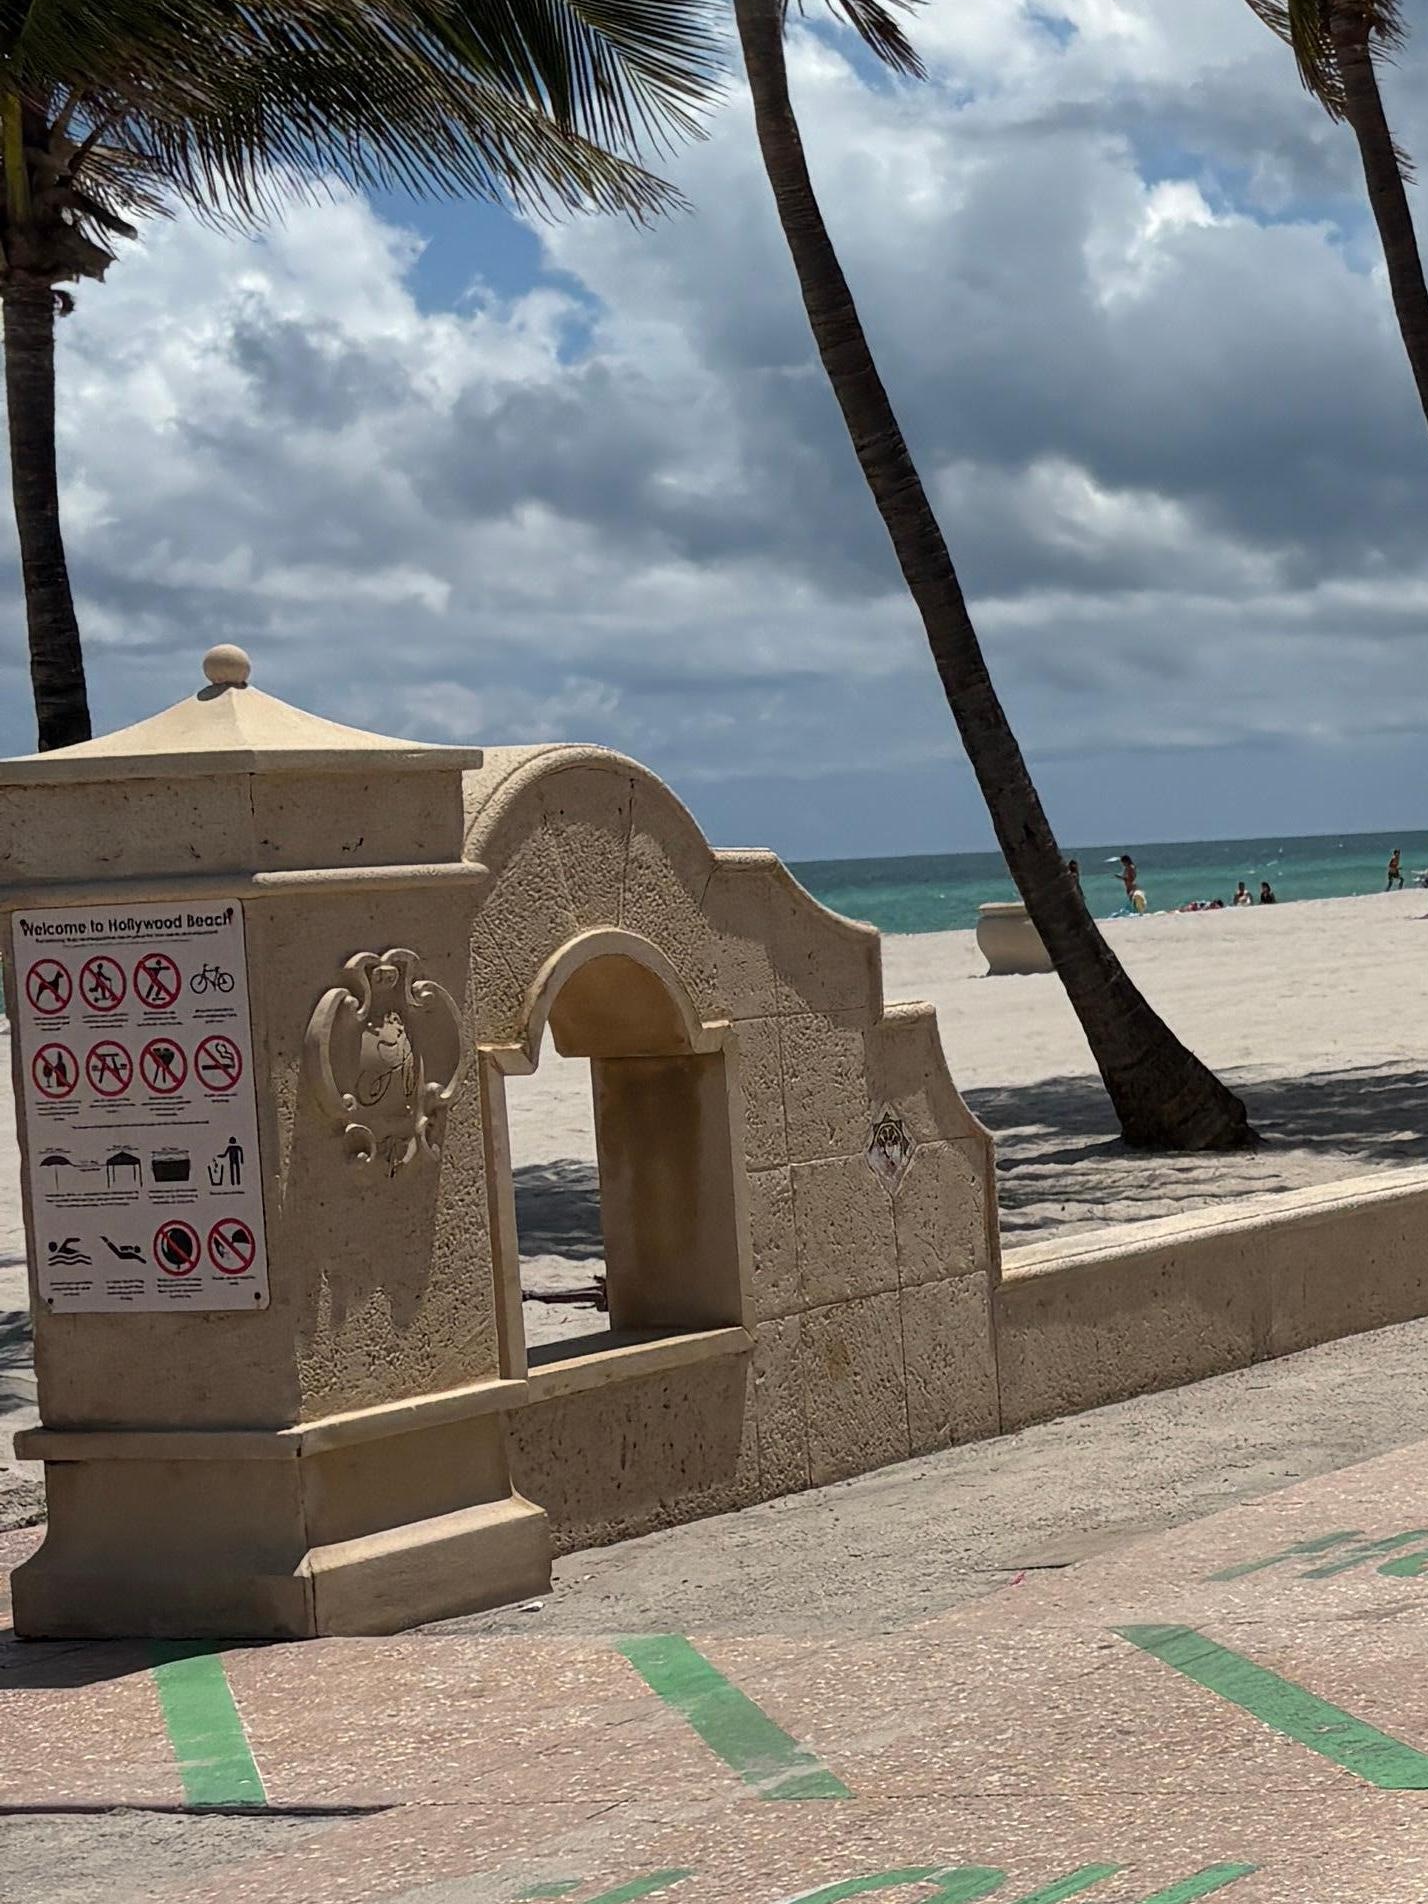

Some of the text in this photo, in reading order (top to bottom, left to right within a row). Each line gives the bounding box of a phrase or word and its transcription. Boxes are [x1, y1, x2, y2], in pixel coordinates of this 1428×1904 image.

[21, 921, 87, 938] Welcome
[91, 919, 104, 934] to
[109, 914, 182, 935] Hollywood
[187, 911, 232, 928] Beach
